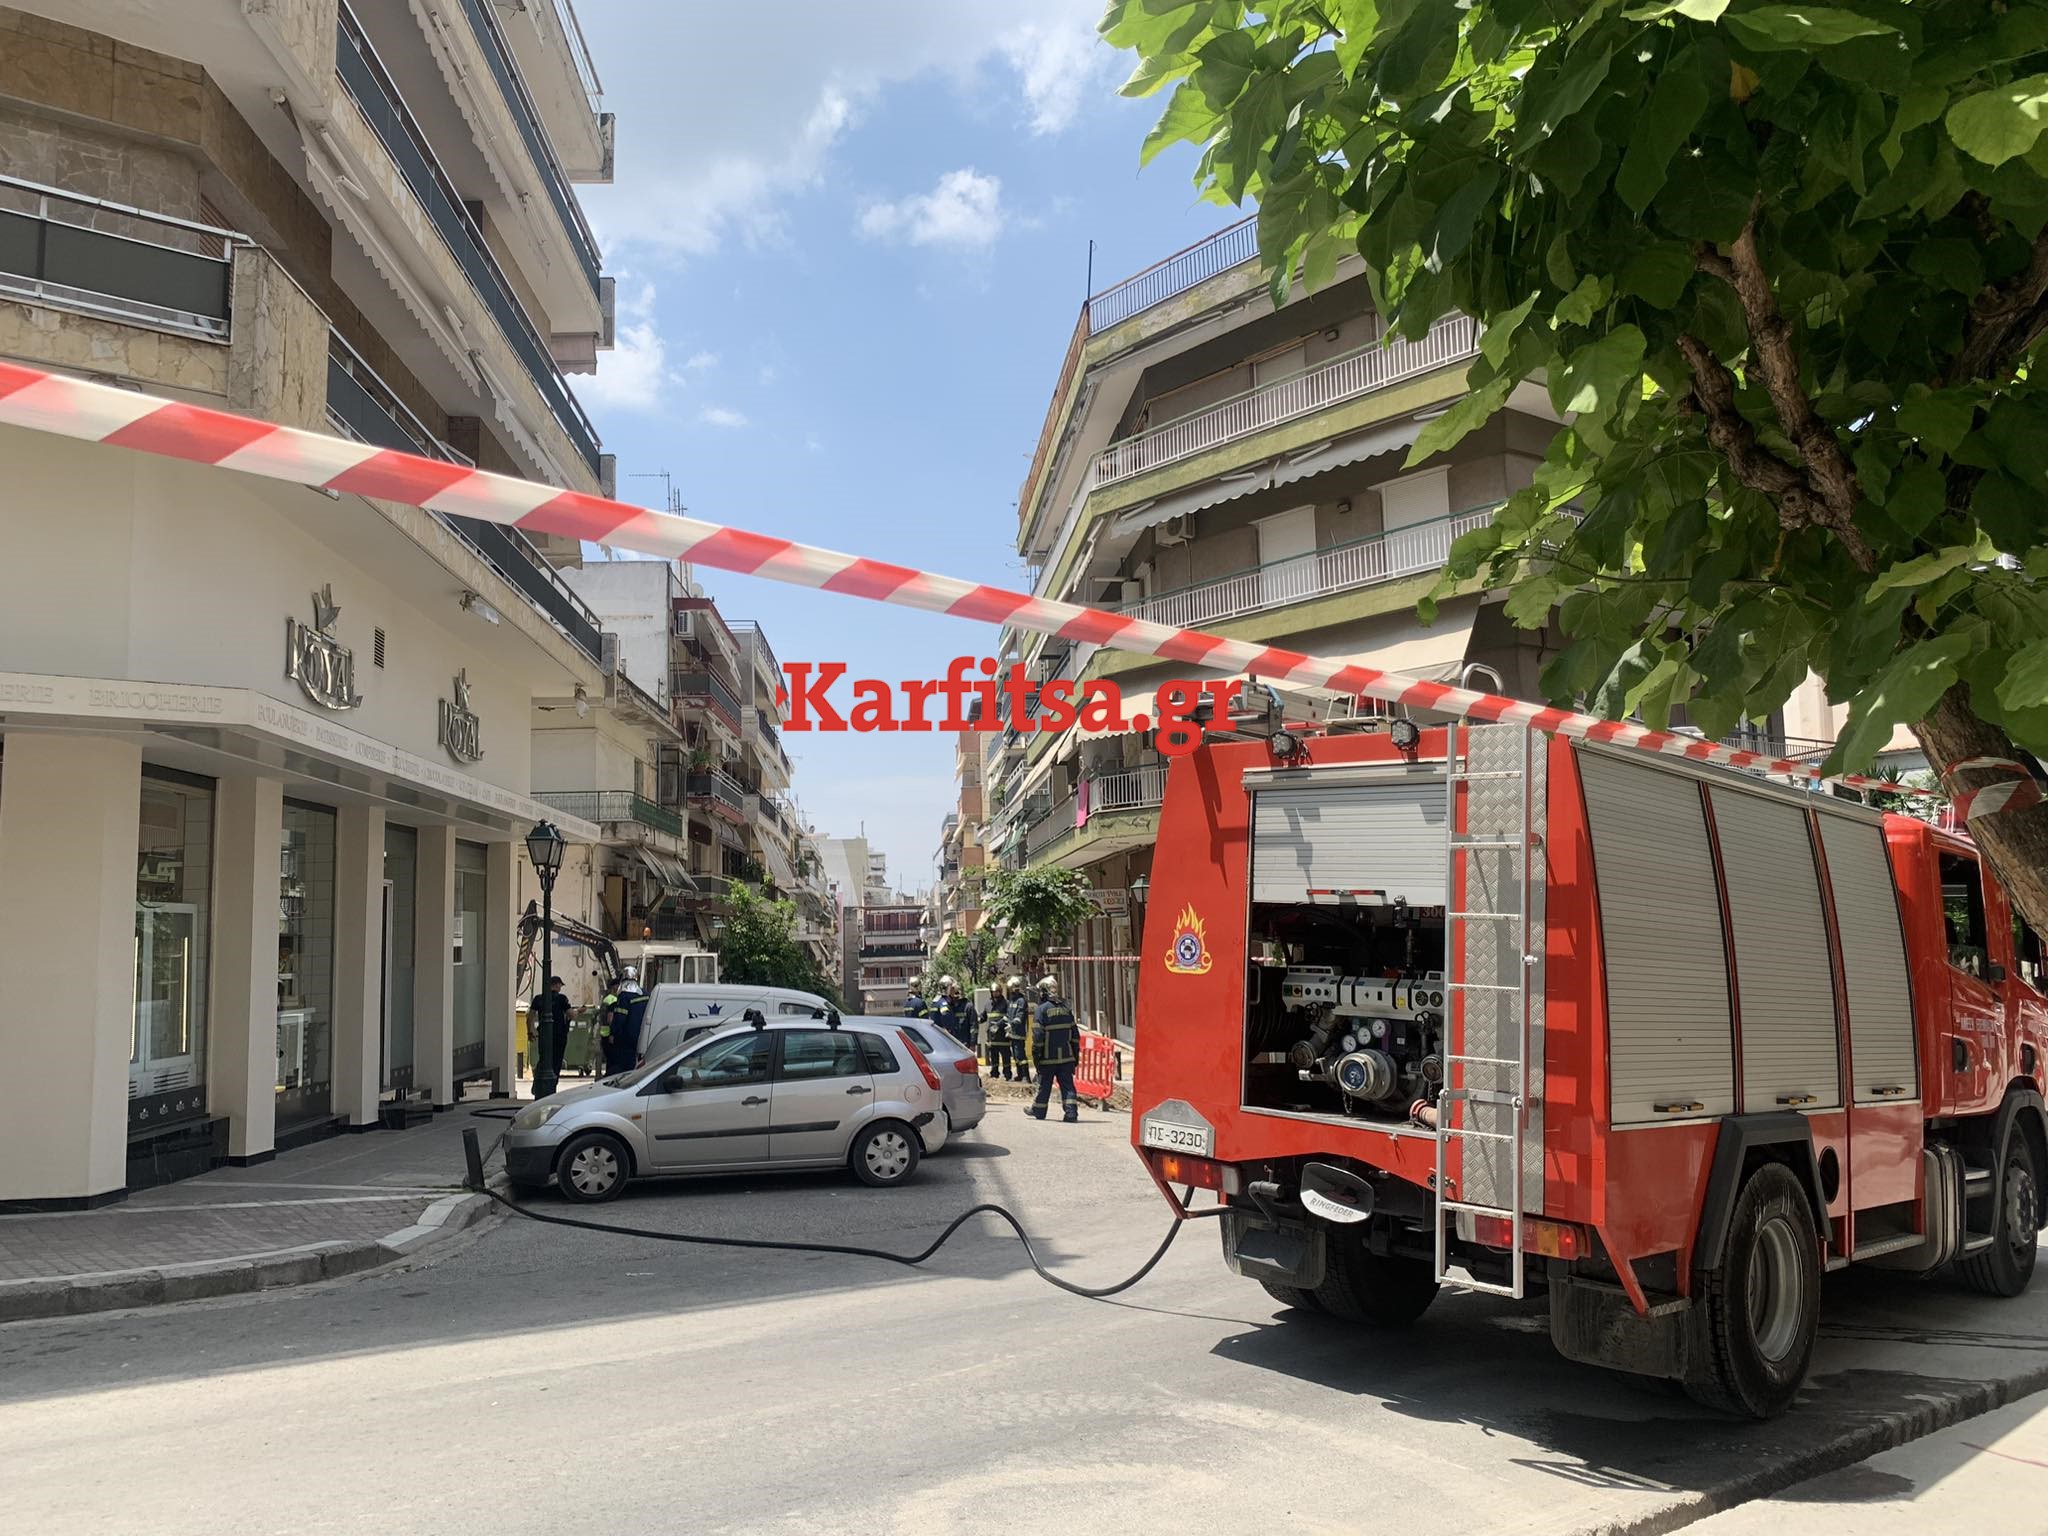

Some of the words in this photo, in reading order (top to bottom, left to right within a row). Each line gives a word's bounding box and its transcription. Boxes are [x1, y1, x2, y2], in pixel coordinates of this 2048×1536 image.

[287, 616, 363, 712] ROYAL
[88, 688, 224, 714] BRIOCHERIE
[438, 698, 485, 764] ROYAL
[1309, 1197, 1354, 1217] RINGFEDER
